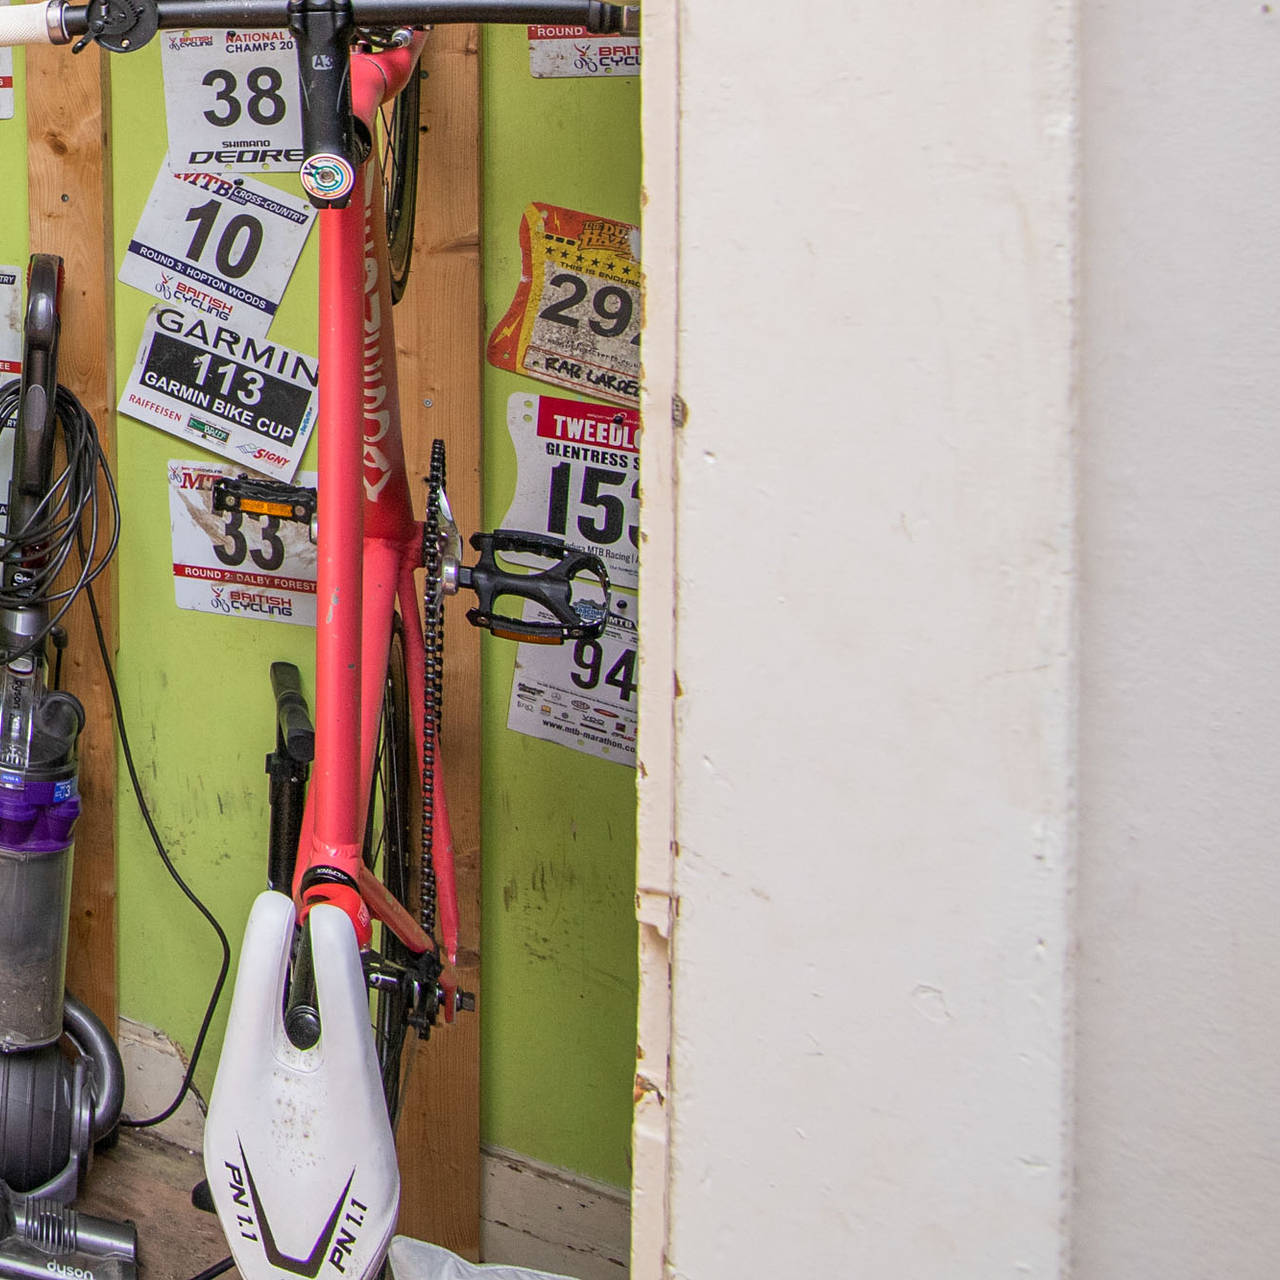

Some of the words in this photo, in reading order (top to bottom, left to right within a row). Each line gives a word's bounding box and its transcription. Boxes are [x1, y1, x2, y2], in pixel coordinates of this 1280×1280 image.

[179, 35, 213, 43] BRITISH
[225, 32, 285, 44] NATIONAL
[537, 26, 583, 37] ROUND
[225, 42, 277, 54] CHAMPS
[598, 45, 640, 56] BRIT
[598, 56, 640, 67] CYCL
[201, 66, 287, 128] 38
[188, 149, 304, 164] DEORE
[222, 139, 271, 148] SHIMANO
[173, 173, 234, 198] MTB
[233, 188, 306, 224] CROSS-COUNTRY
[185, 199, 264, 279] 10
[139, 246, 175, 268] ROUND
[175, 260, 185, 272] 3:
[186, 264, 227, 291] HOPTON
[228, 283, 267, 310] WOODS
[173, 289, 231, 322] CYCLING
[175, 281, 234, 314] BRITISH
[538, 273, 640, 346] 29
[156, 308, 319, 388] GARMIN
[193, 353, 265, 406] 113
[128, 393, 182, 422] RAIFFEISEN
[144, 371, 210, 408] GARMIN
[212, 400, 254, 426] BIKE
[257, 417, 294, 441] CUP
[253, 448, 291, 467] SIGNY
[546, 442, 629, 469] GLENTRESS
[213, 512, 286, 571] 33
[587, 545, 604, 557] MTB
[605, 549, 631, 564] Racing
[185, 567, 221, 579] ROUND
[236, 573, 271, 586] DALBY
[274, 578, 317, 591] FOREST
[229, 591, 293, 607] BRITISH
[231, 600, 293, 617] CYCLING
[570, 638, 638, 702] 94
[542, 719, 637, 754] www.mtb-marathon.co
[224, 1160, 249, 1208] PN
[237, 1214, 258, 1243] 1.1
[328, 1227, 357, 1274] PN
[345, 1197, 368, 1228] 1.1
[46, 1258, 94, 1280] dyson
